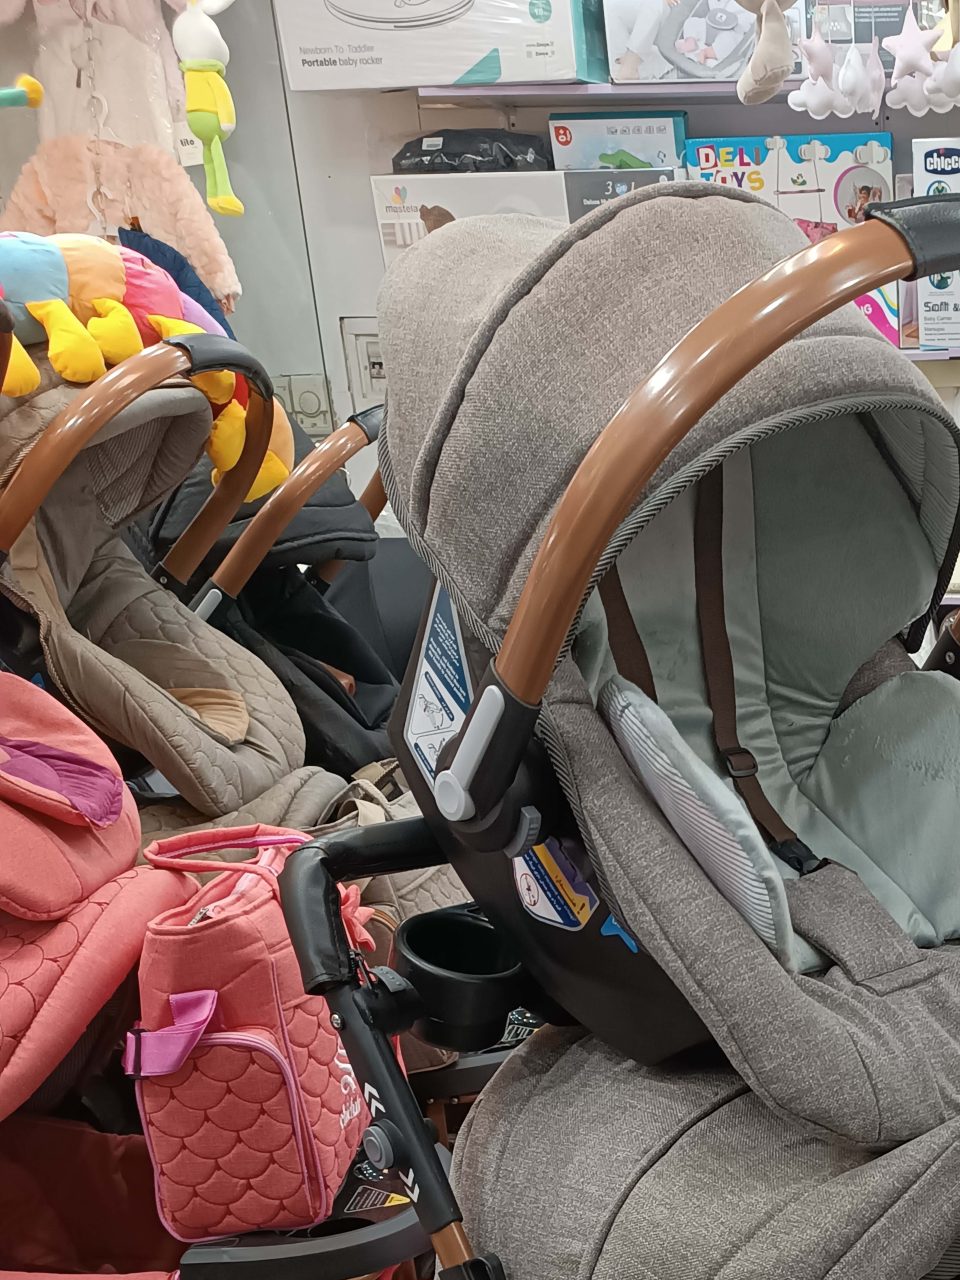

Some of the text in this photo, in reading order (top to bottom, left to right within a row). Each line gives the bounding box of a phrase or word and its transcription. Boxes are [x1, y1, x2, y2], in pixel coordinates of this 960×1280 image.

[301, 57, 383, 68] Portable baby rocker
[697, 145, 762, 170] DELI
[700, 170, 765, 191] TOYS
[604, 181, 613, 194] 3
[923, 301, 949, 313] Soft
[952, 303, 960, 312] &
